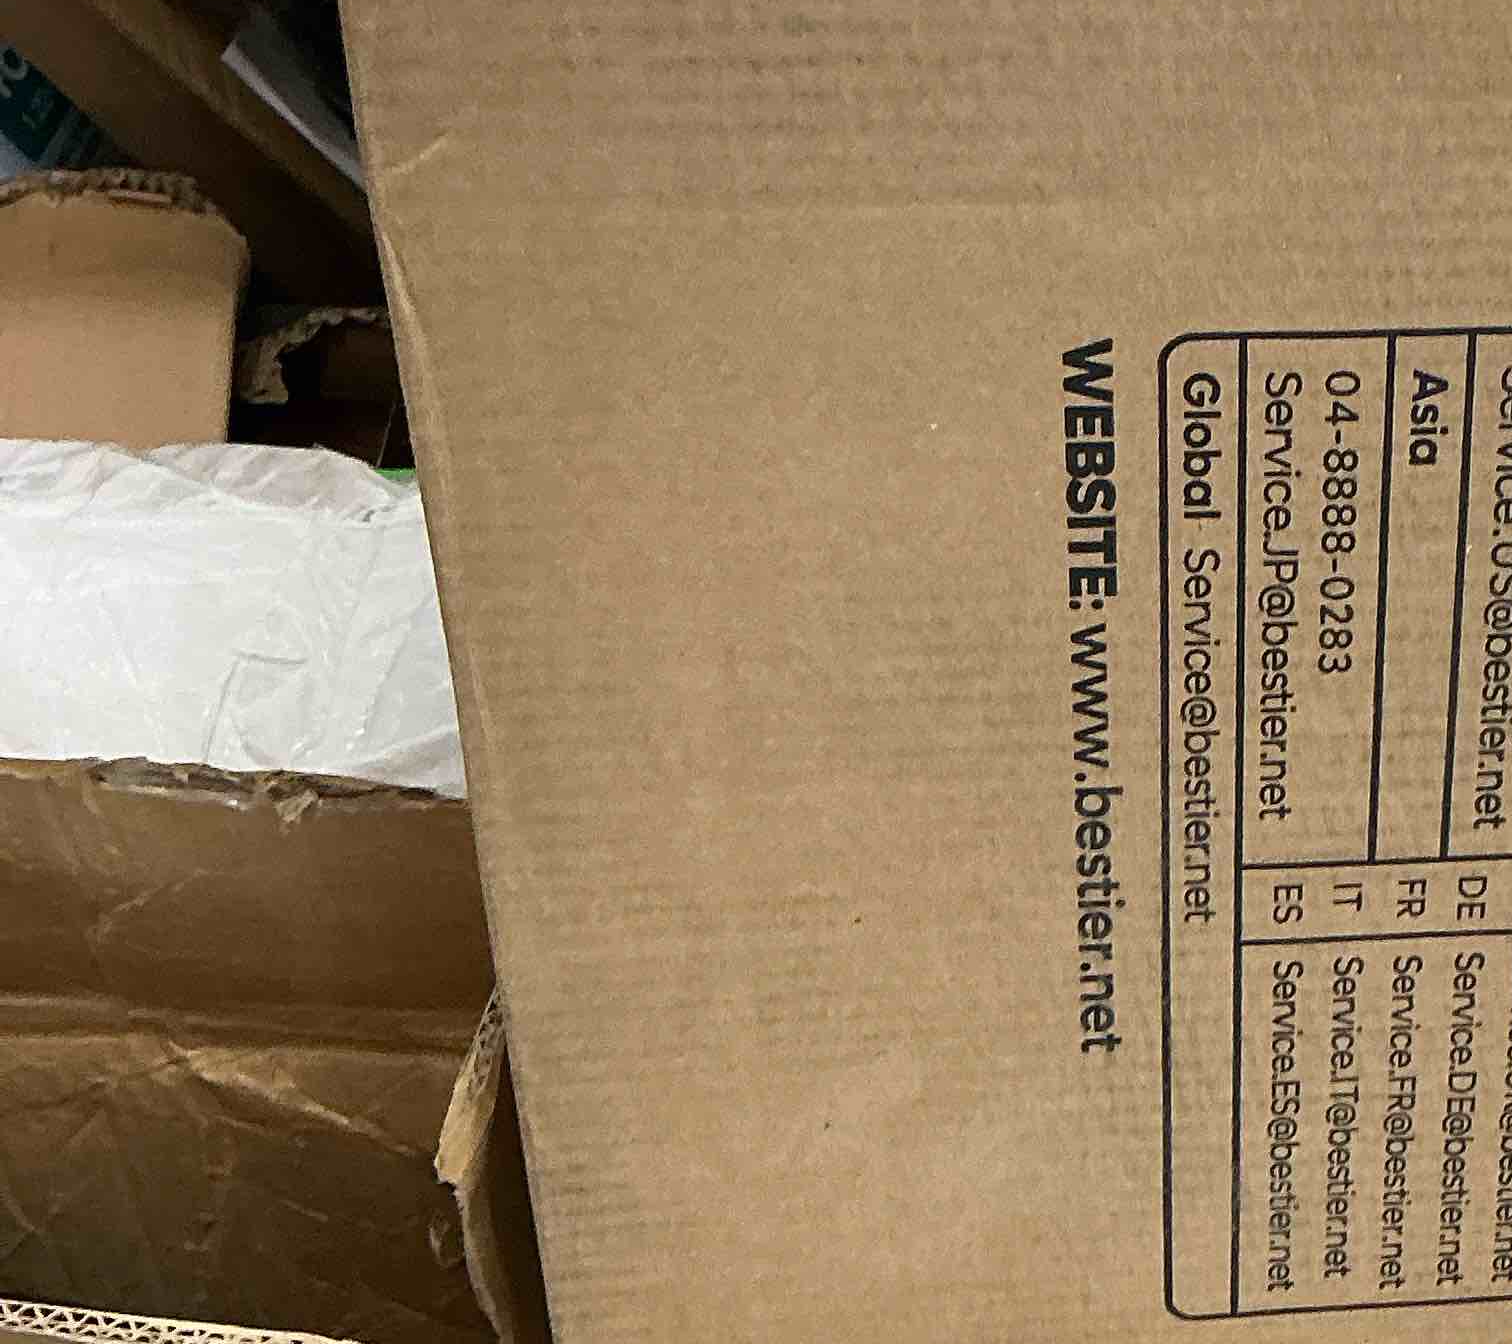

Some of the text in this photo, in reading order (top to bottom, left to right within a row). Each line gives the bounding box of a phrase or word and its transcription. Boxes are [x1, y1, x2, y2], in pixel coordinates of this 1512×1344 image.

[1257, 372, 1303, 822] Service.JP@bestier.net
[1318, 370, 1361, 675] 04-8888-0283
[1409, 369, 1450, 466] Asia
[1061, 337, 1125, 1055] WEBSITE: www.bestier.net
[1177, 372, 1222, 924] Global Service@bestier.net
[1265, 885, 1305, 1294] ES Service.ES@bestier.net
[1322, 882, 1364, 1280] IT Service.IT@bestier.net
[1378, 877, 1427, 1292] FR Service.FR@bestier.net
[1436, 875, 1488, 1287] DE Service.DE@bestier.net
